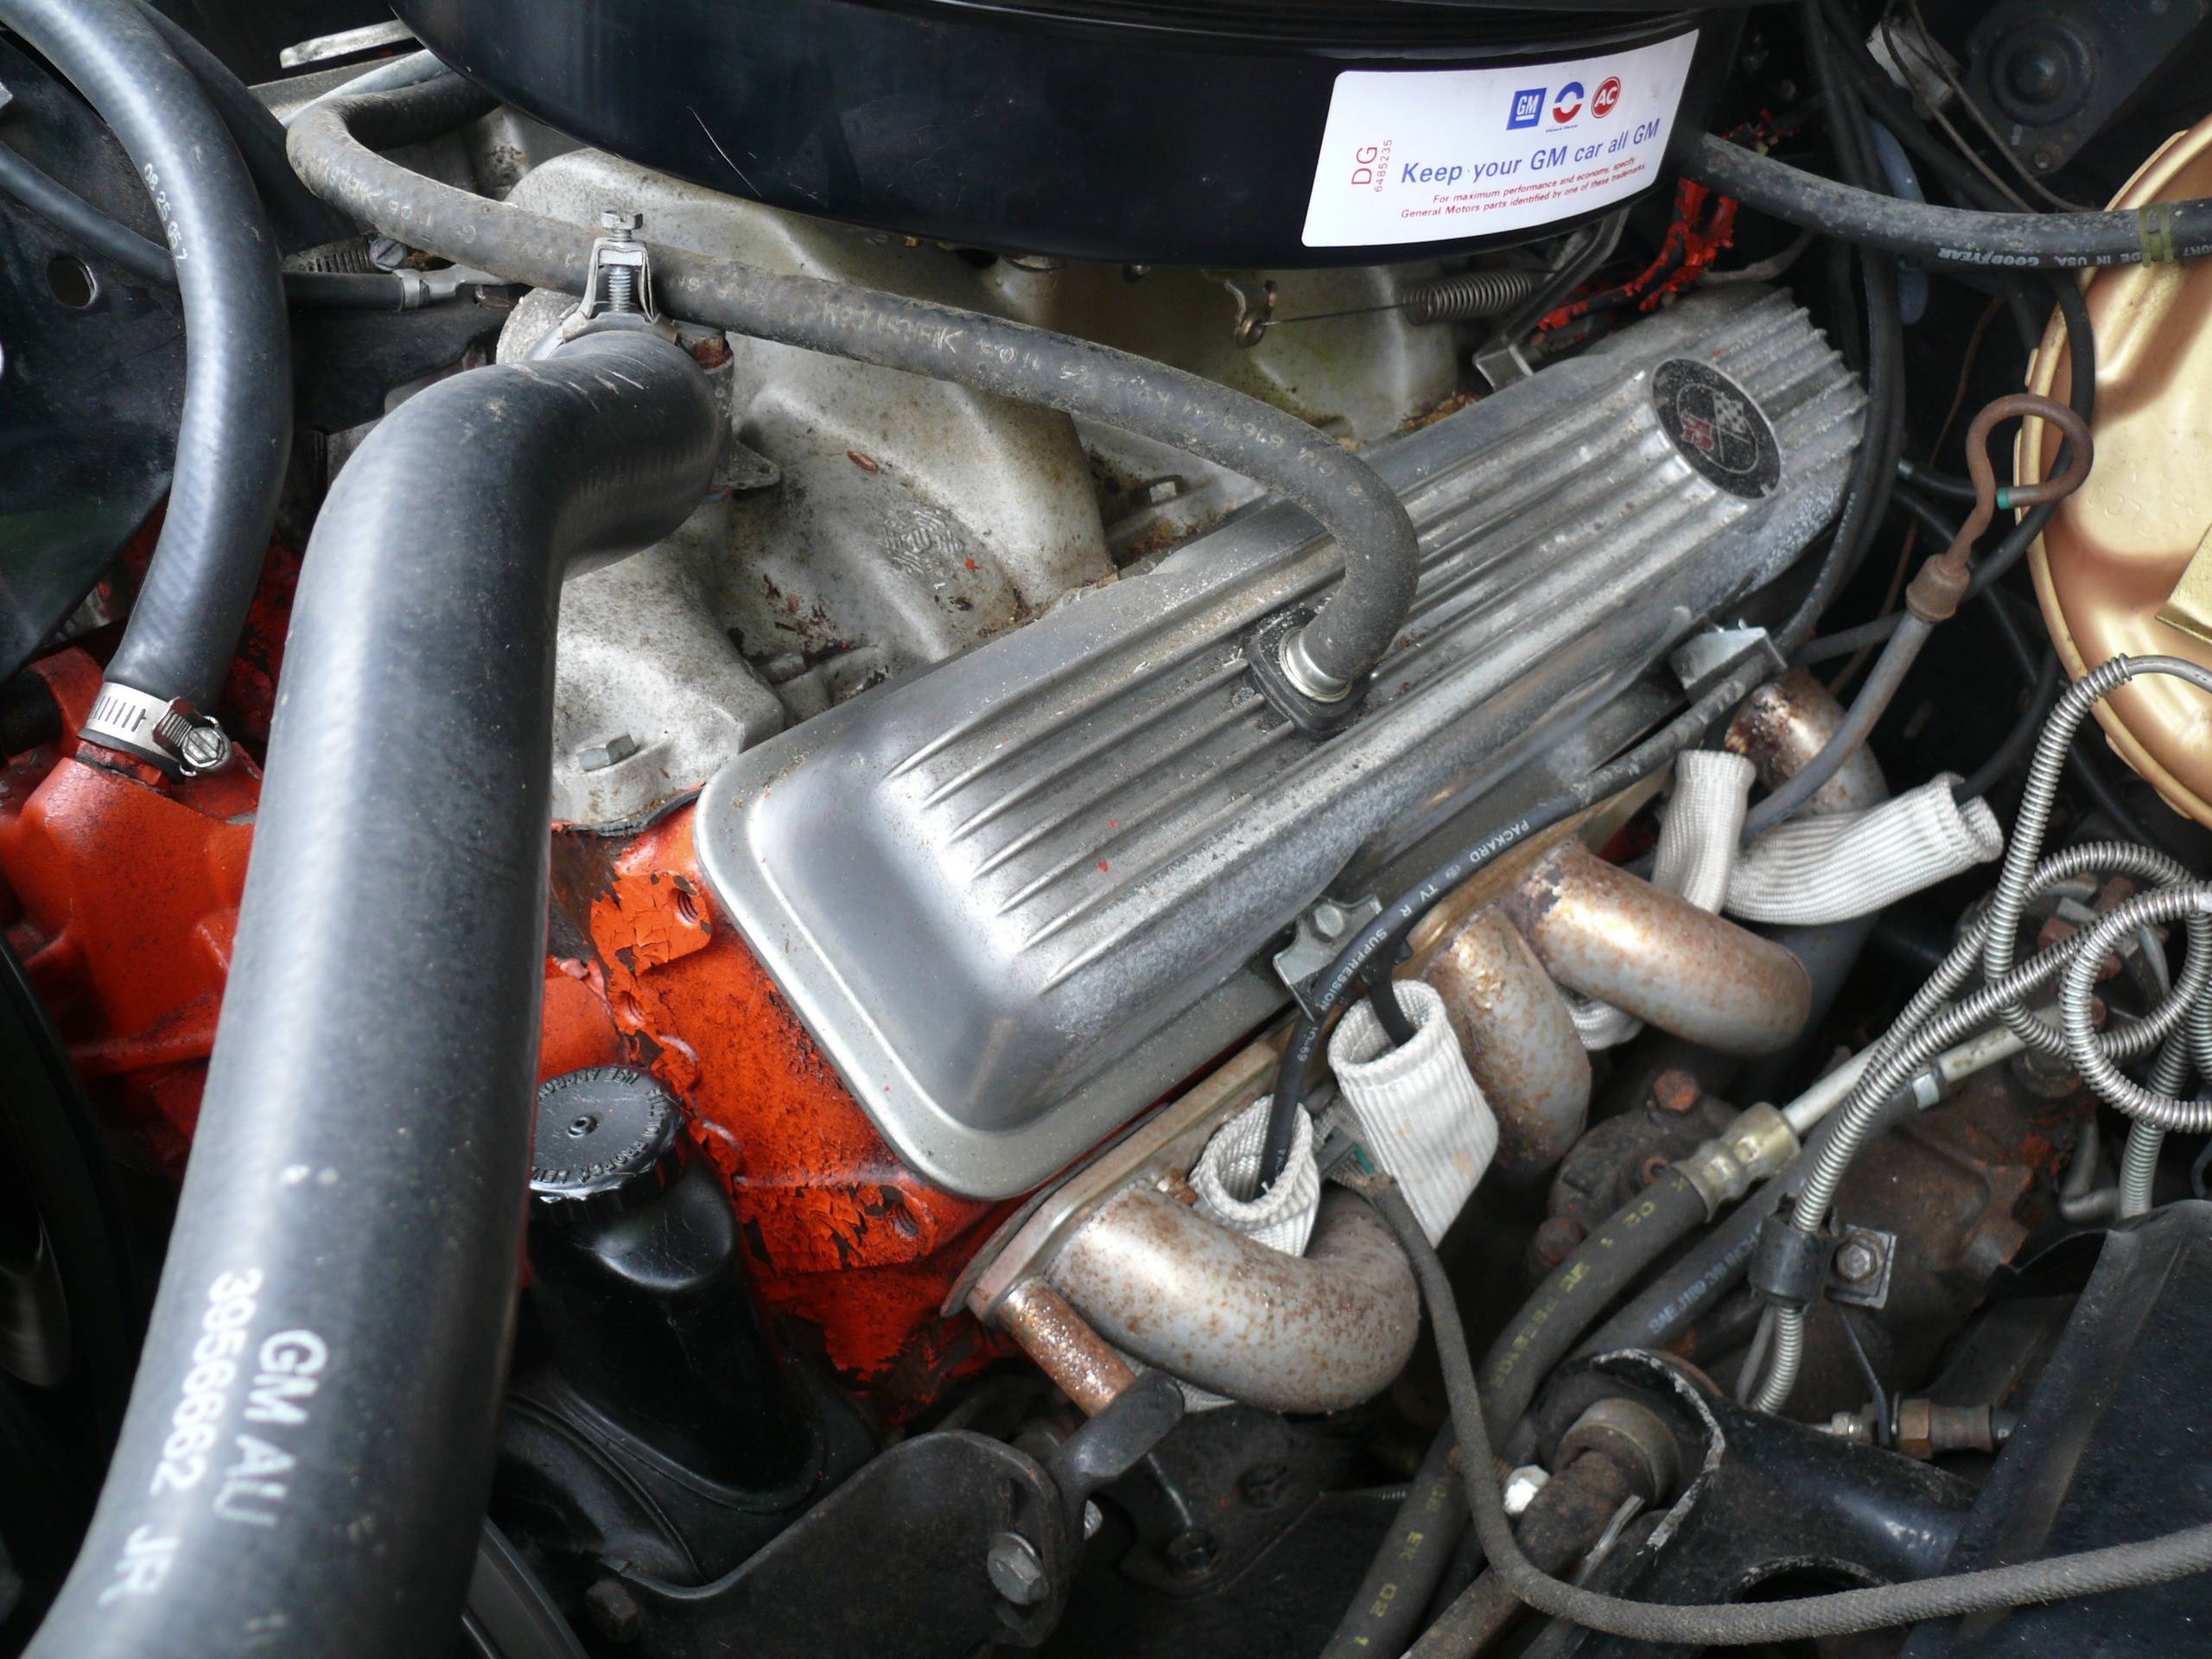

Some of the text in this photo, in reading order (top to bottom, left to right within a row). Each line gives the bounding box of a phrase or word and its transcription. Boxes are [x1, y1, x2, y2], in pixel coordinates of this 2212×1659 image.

[1517, 95, 1540, 116] GM
[1594, 87, 1618, 108] AC
[1351, 146, 1378, 185] DG
[1374, 138, 1393, 193] 6485235
[1401, 118, 1661, 186] Keep your GM car all GM
[1401, 163, 1646, 219] General Motors parts identified by one of these trademarks
[1433, 194, 1450, 204] For
[1452, 189, 1500, 202] maximum
[1503, 180, 1556, 197] performance
[1560, 174, 1574, 186] and
[1612, 156, 1637, 172] specify
[1937, 247, 2040, 266] GOODYEAR
[2096, 254, 2111, 264] IN
[2120, 252, 2143, 264] DE
[1469, 819, 1530, 863] PACKARD
[1399, 904, 1413, 918] R
[1315, 926, 1388, 1012] SUPPRESSION
[538, 1067, 639, 1102] USE APPROV
[149, 1267, 264, 1497] 3956662
[212, 1328, 328, 1529] GM AU
[98, 1524, 181, 1606] JR
